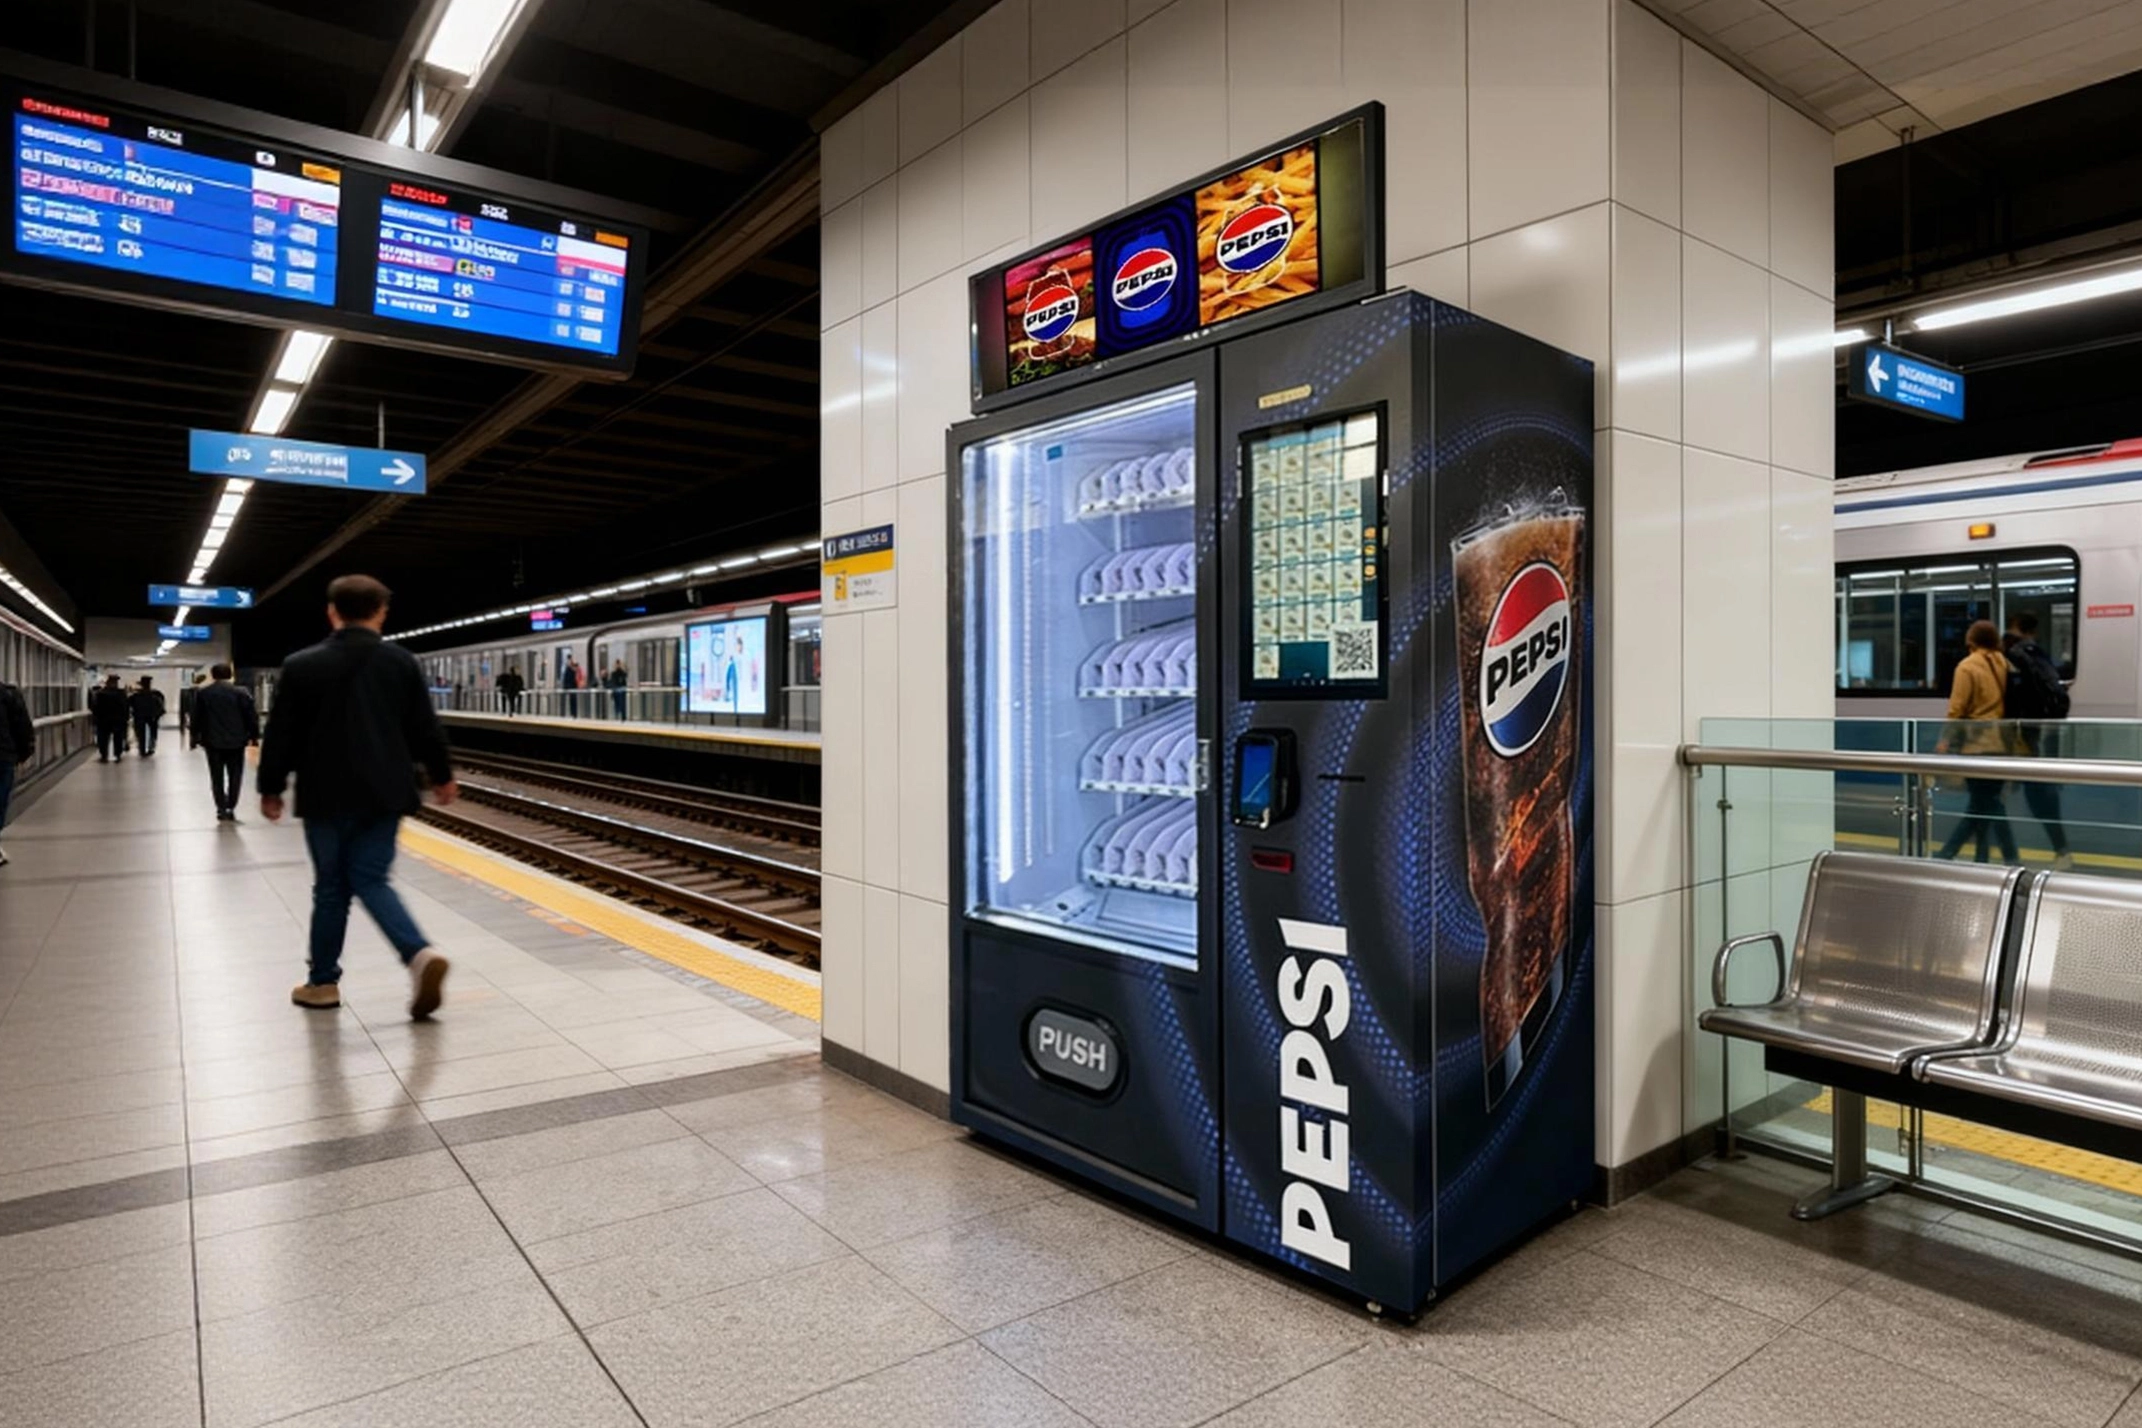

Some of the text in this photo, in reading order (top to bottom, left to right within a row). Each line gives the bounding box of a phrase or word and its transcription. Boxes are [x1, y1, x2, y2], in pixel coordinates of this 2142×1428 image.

[1220, 221, 1288, 256] PEPSI
[1486, 615, 1567, 706] PEPSI
[1039, 1025, 1106, 1072] PUSH
[1277, 918, 1350, 1271] PEPSI
